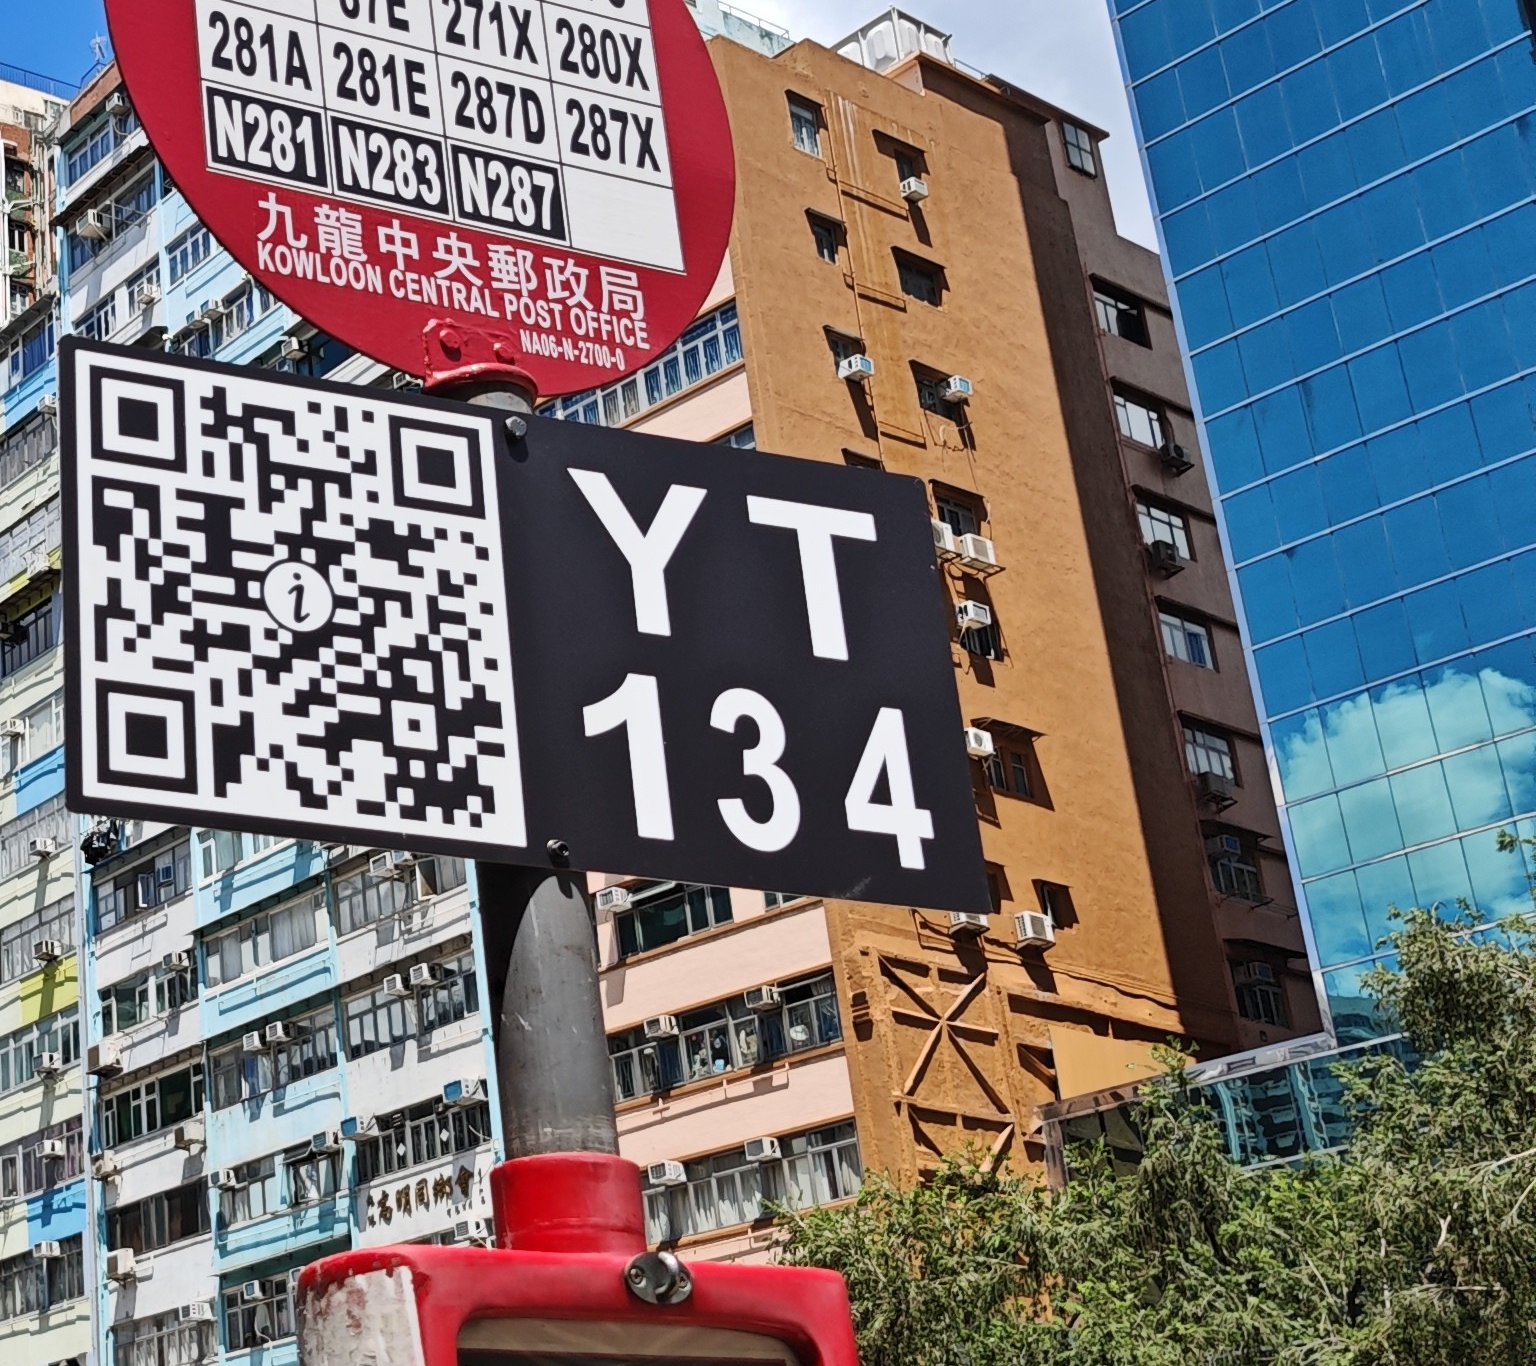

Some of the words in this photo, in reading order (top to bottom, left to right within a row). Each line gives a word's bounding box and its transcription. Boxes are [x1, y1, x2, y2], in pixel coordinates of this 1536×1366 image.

[208, 11, 312, 90] 281A
[333, 41, 430, 119] 281E
[450, 70, 546, 144] 287D
[566, 99, 661, 174] 287X
[556, 18, 649, 91] 280X
[214, 96, 318, 179] N281
[336, 125, 443, 205] N283
[458, 156, 555, 233] N287
[257, 192, 646, 321] 九龍中央郵政局
[257, 241, 383, 295] KOWLOON
[389, 270, 499, 319] CENTRAL
[504, 293, 562, 331] POST
[570, 307, 650, 351] OFFICE
[520, 328, 625, 372] NA06-N-2700-0
[568, 468, 877, 661] YT
[583, 673, 934, 870] 134
